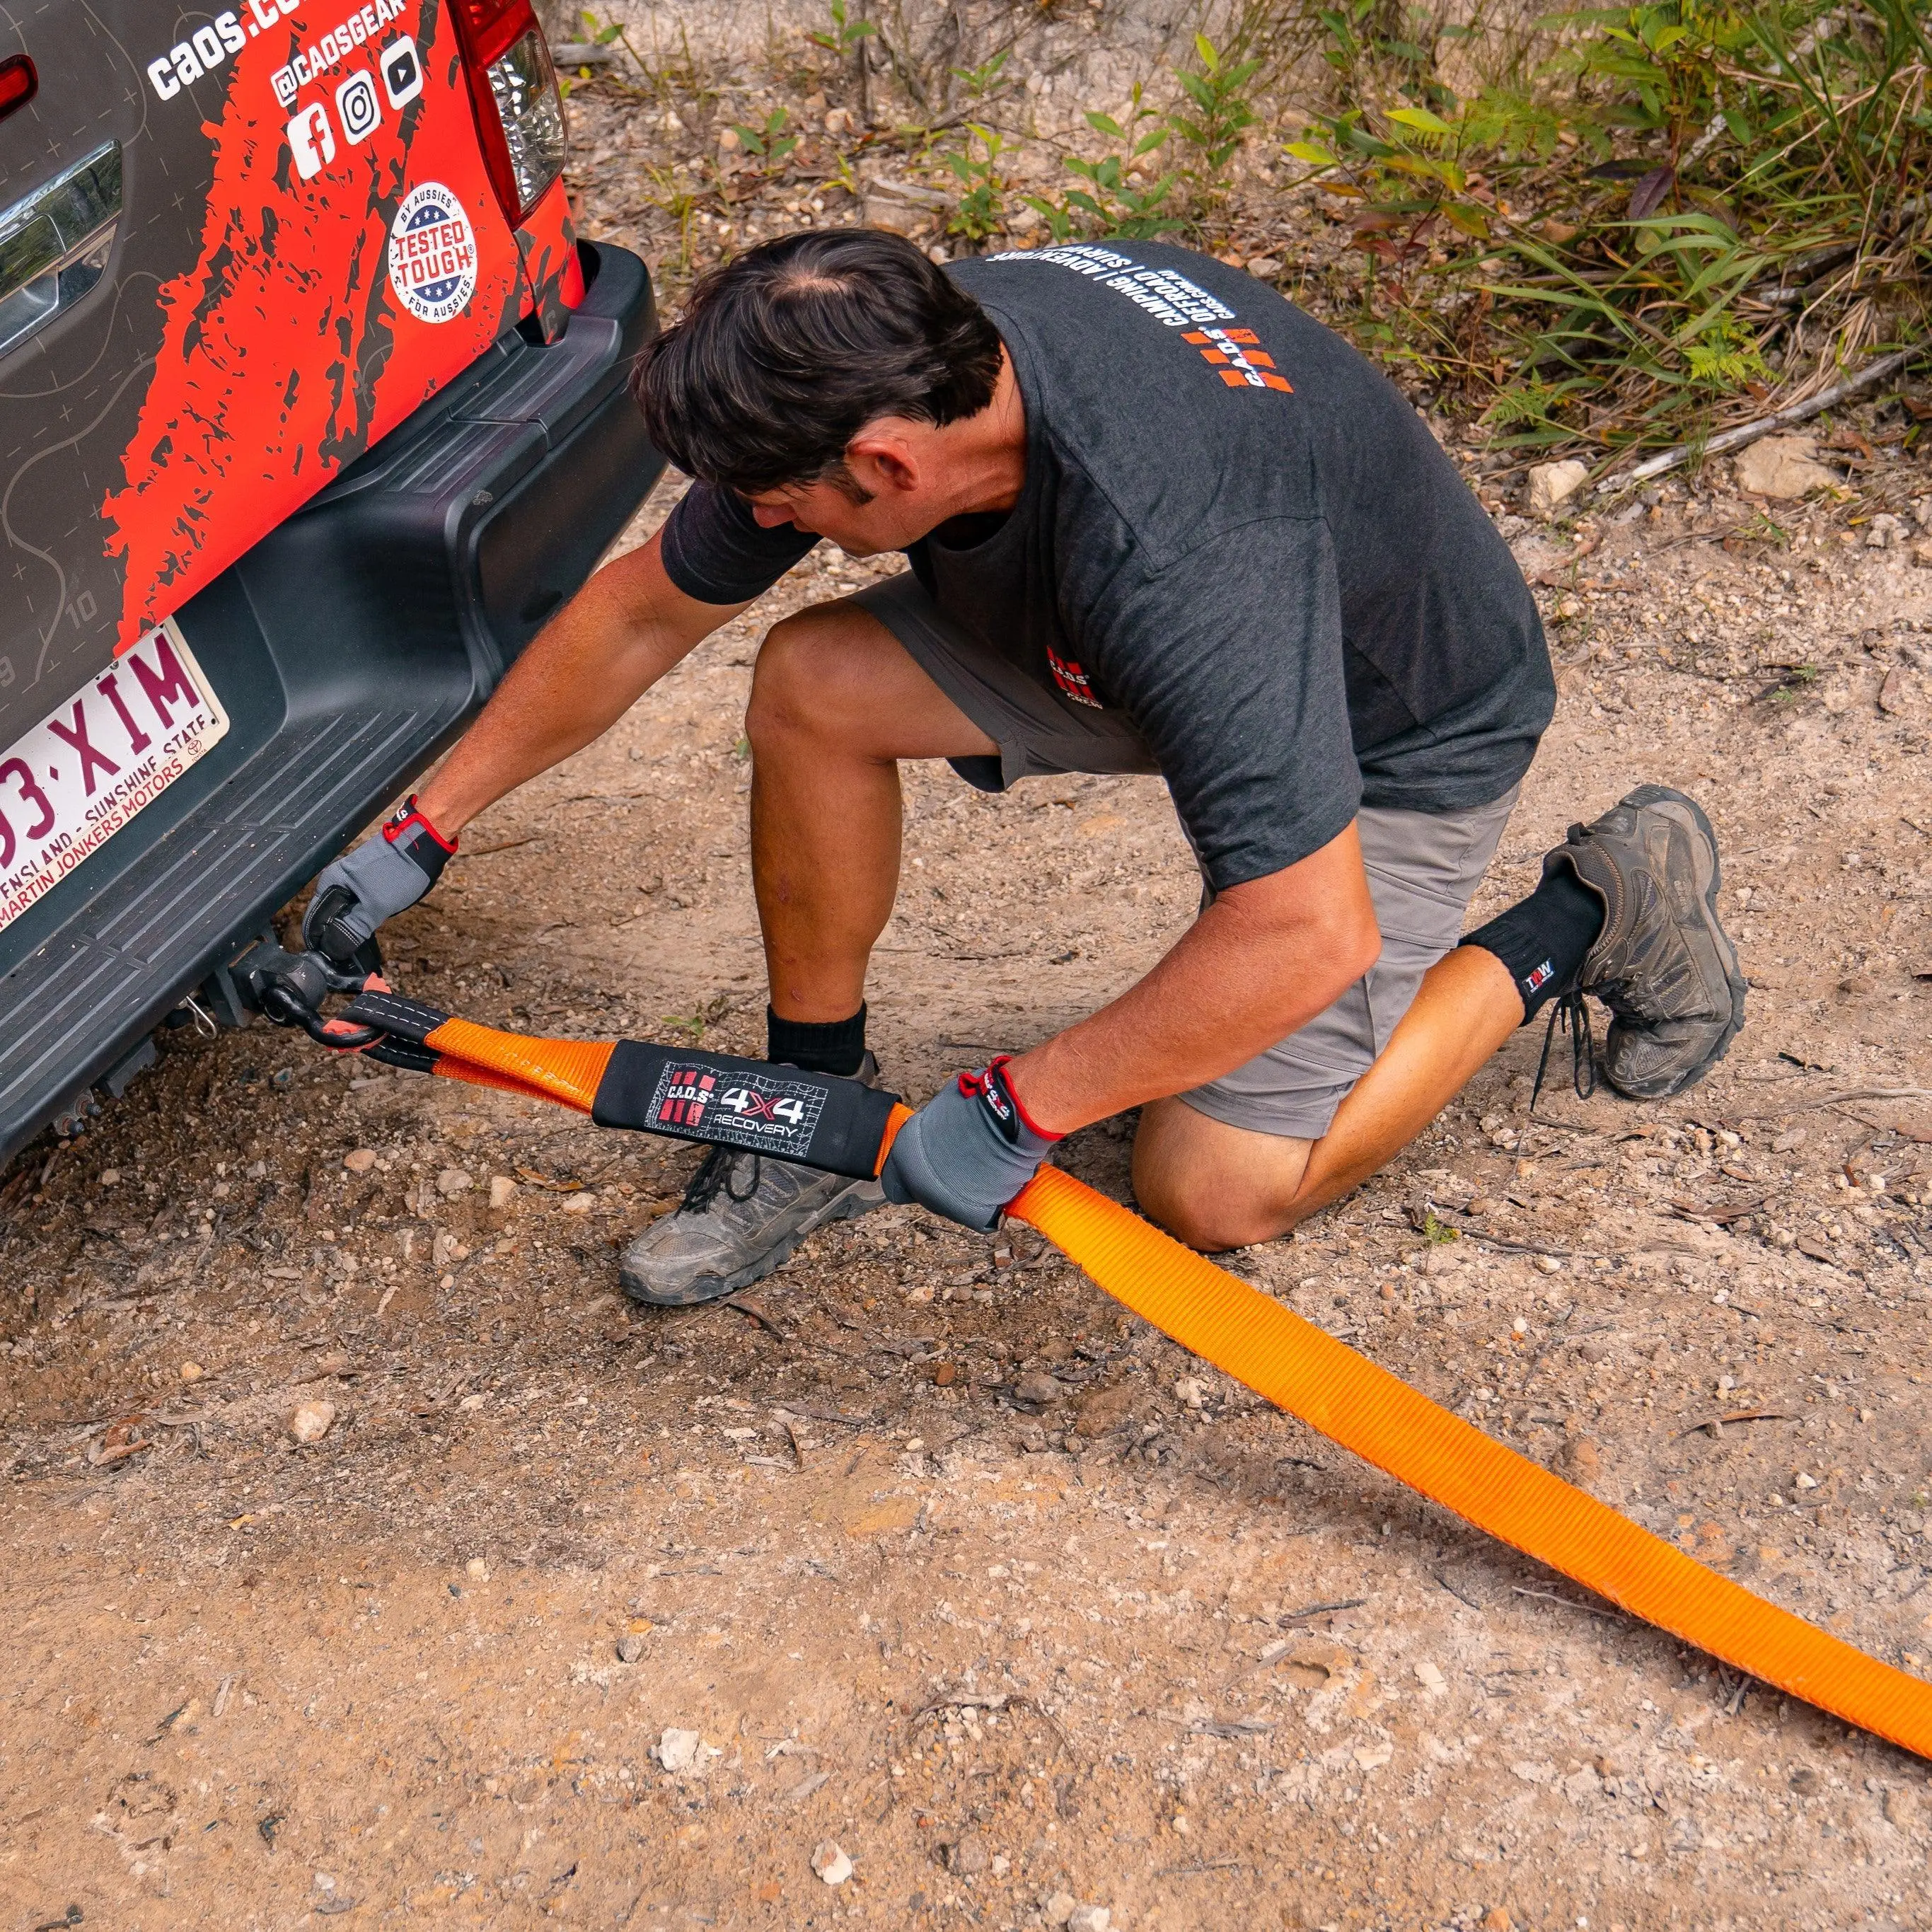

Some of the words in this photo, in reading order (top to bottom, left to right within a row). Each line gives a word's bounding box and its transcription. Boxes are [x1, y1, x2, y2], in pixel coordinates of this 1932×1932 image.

[400, 204, 411, 223] BY
[414, 190, 452, 209] AUSSIES
[395, 221, 465, 260] TESTED
[408, 296, 429, 316] FOR
[434, 280, 470, 318] AUSSIES
[1106, 276, 1190, 327] CAMPING
[1133, 271, 1217, 322] OFFROAD
[65, 589, 98, 630] 10
[85, 755, 157, 823] SUNSHINE
[163, 714, 206, 755] STATE
[0, 870, 55, 928] MARTIN
[57, 811, 124, 878] JONKERS
[122, 758, 183, 818] MOTORS
[713, 1113, 799, 1138] RECOVERY
